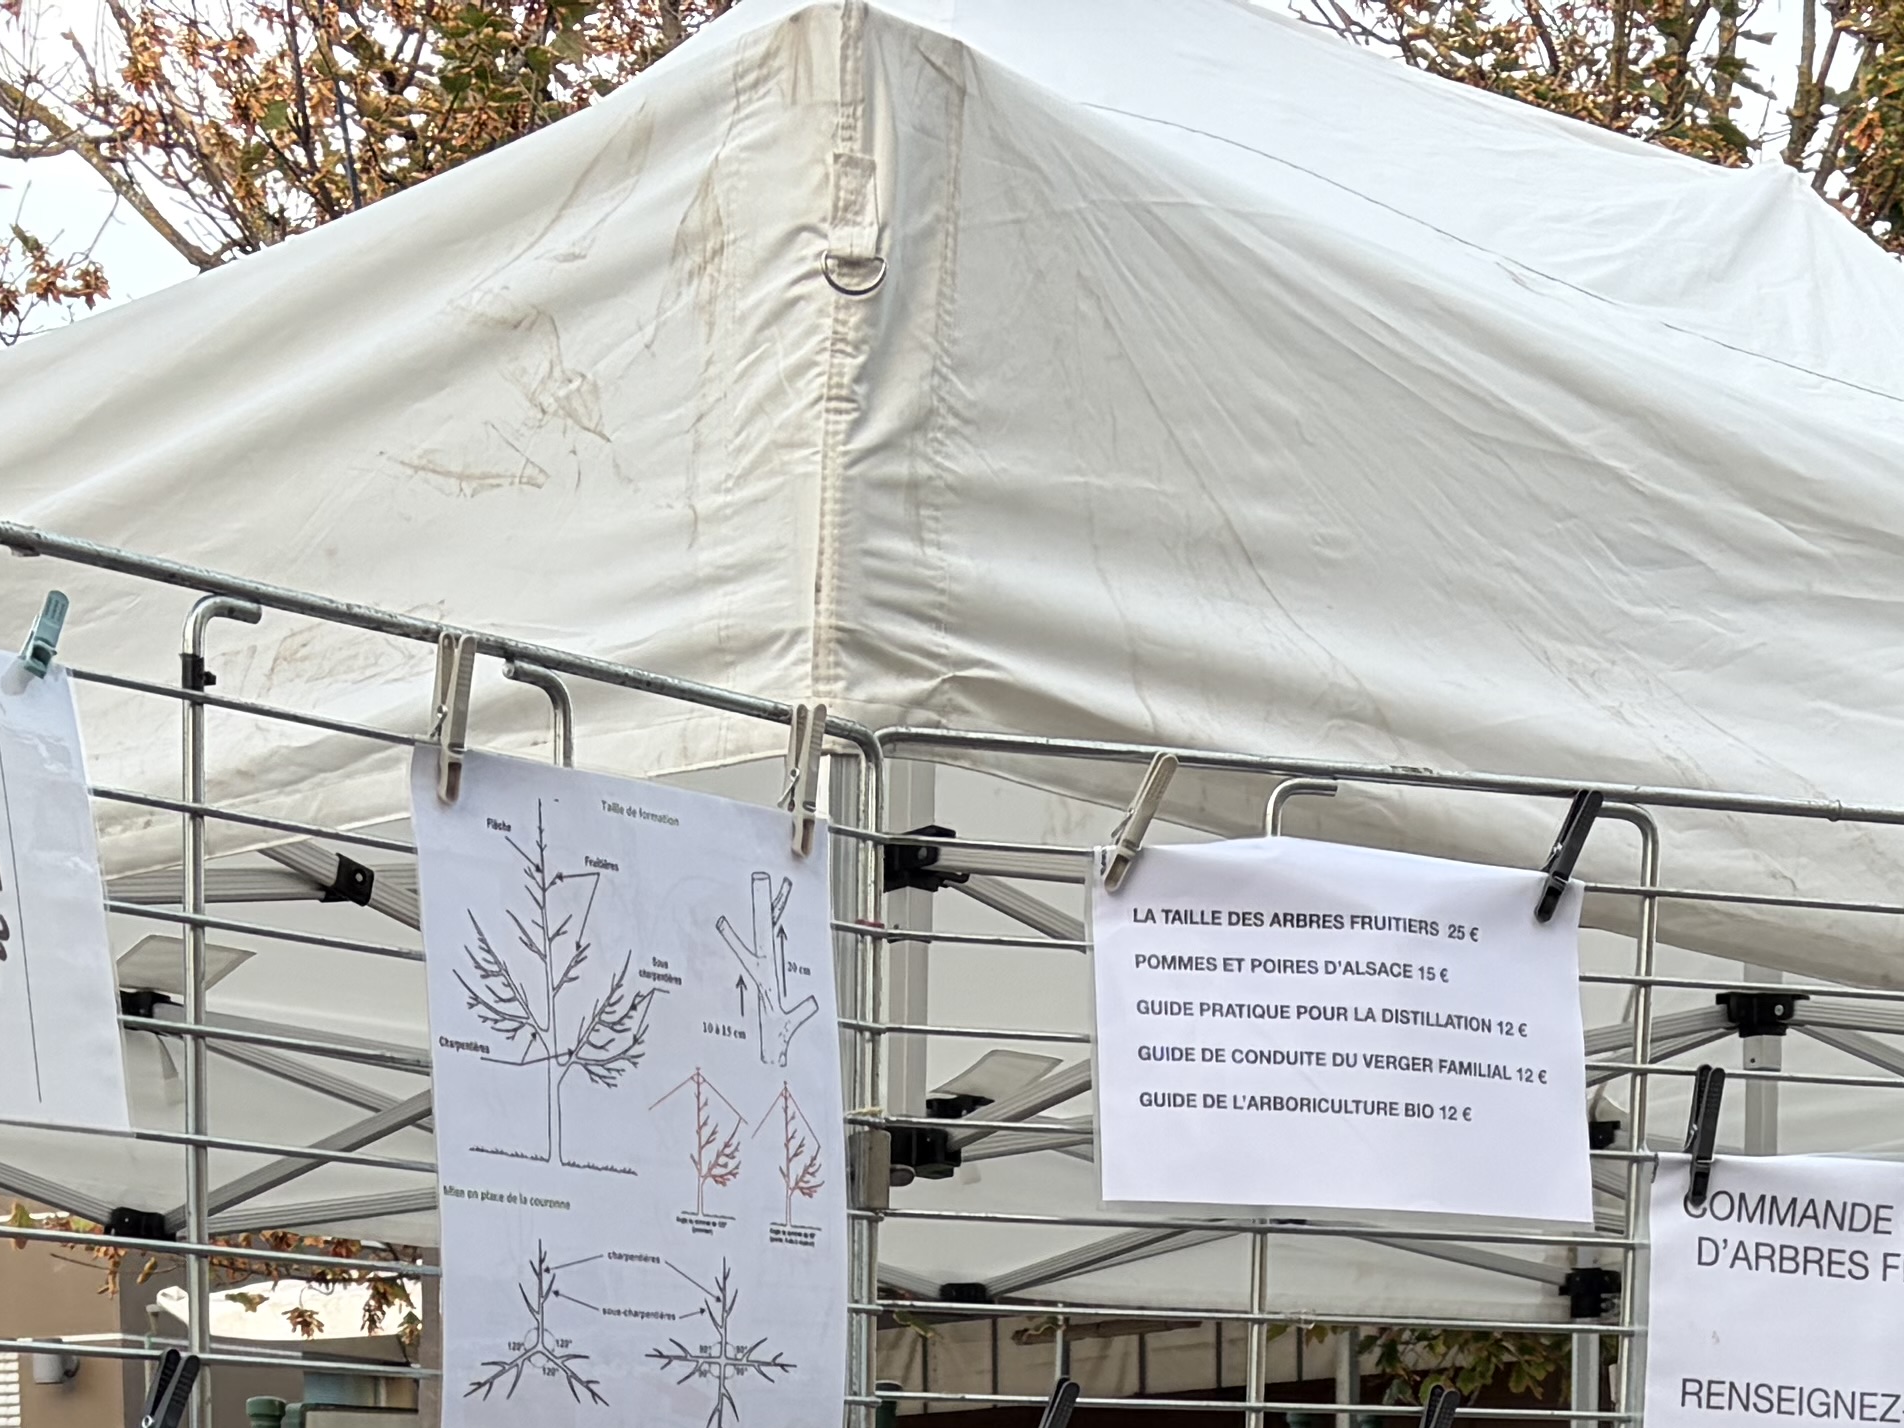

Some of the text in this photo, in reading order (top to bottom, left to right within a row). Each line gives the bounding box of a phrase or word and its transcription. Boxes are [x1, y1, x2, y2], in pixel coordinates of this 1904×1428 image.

[1133, 907, 1479, 943] LA TAILLE DES ARBRES FRUITIERS 25 €
[1134, 953, 1449, 983] POMMES ET POIRES D'ALSACE 15 €
[1136, 999, 1528, 1038] GUIDE PRATIQUE POUR LA DISTILLATION 12 €
[1138, 1045, 1547, 1085] GUIDE DE CONDUITE DU VERGER FAMILIAL 12 €
[1139, 1091, 1472, 1122] GUIDE DE L'ARBORICULTURE BIO 12 €
[1697, 1236, 1870, 1281] D'ARBRES
